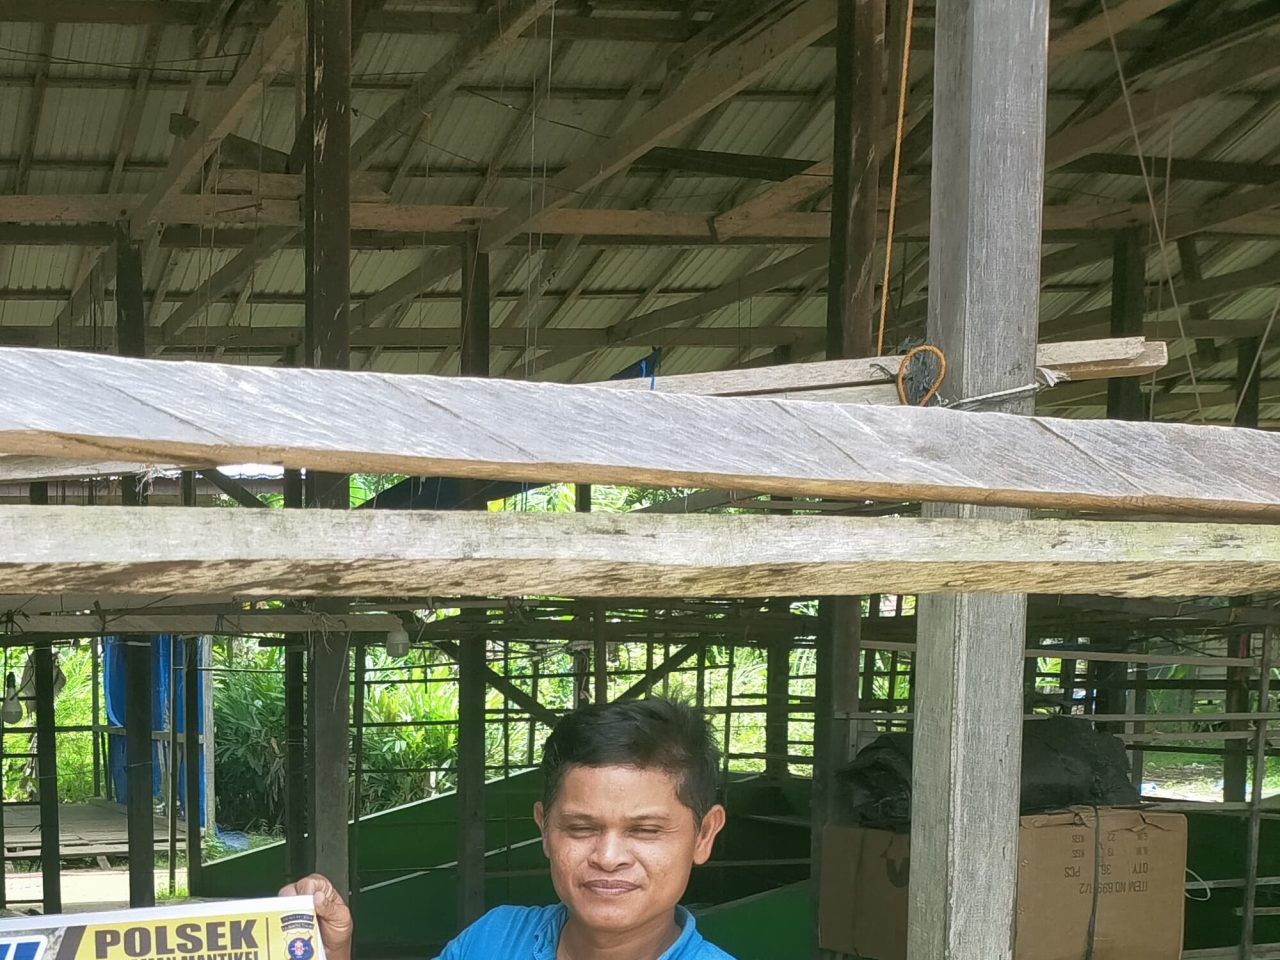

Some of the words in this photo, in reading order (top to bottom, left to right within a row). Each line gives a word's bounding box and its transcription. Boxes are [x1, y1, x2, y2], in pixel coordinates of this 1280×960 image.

[1063, 866, 1081, 878] PCS
[1132, 862, 1149, 874] QTY
[1128, 880, 1148, 893] ITEM
[94, 919, 259, 959] POLSEK
